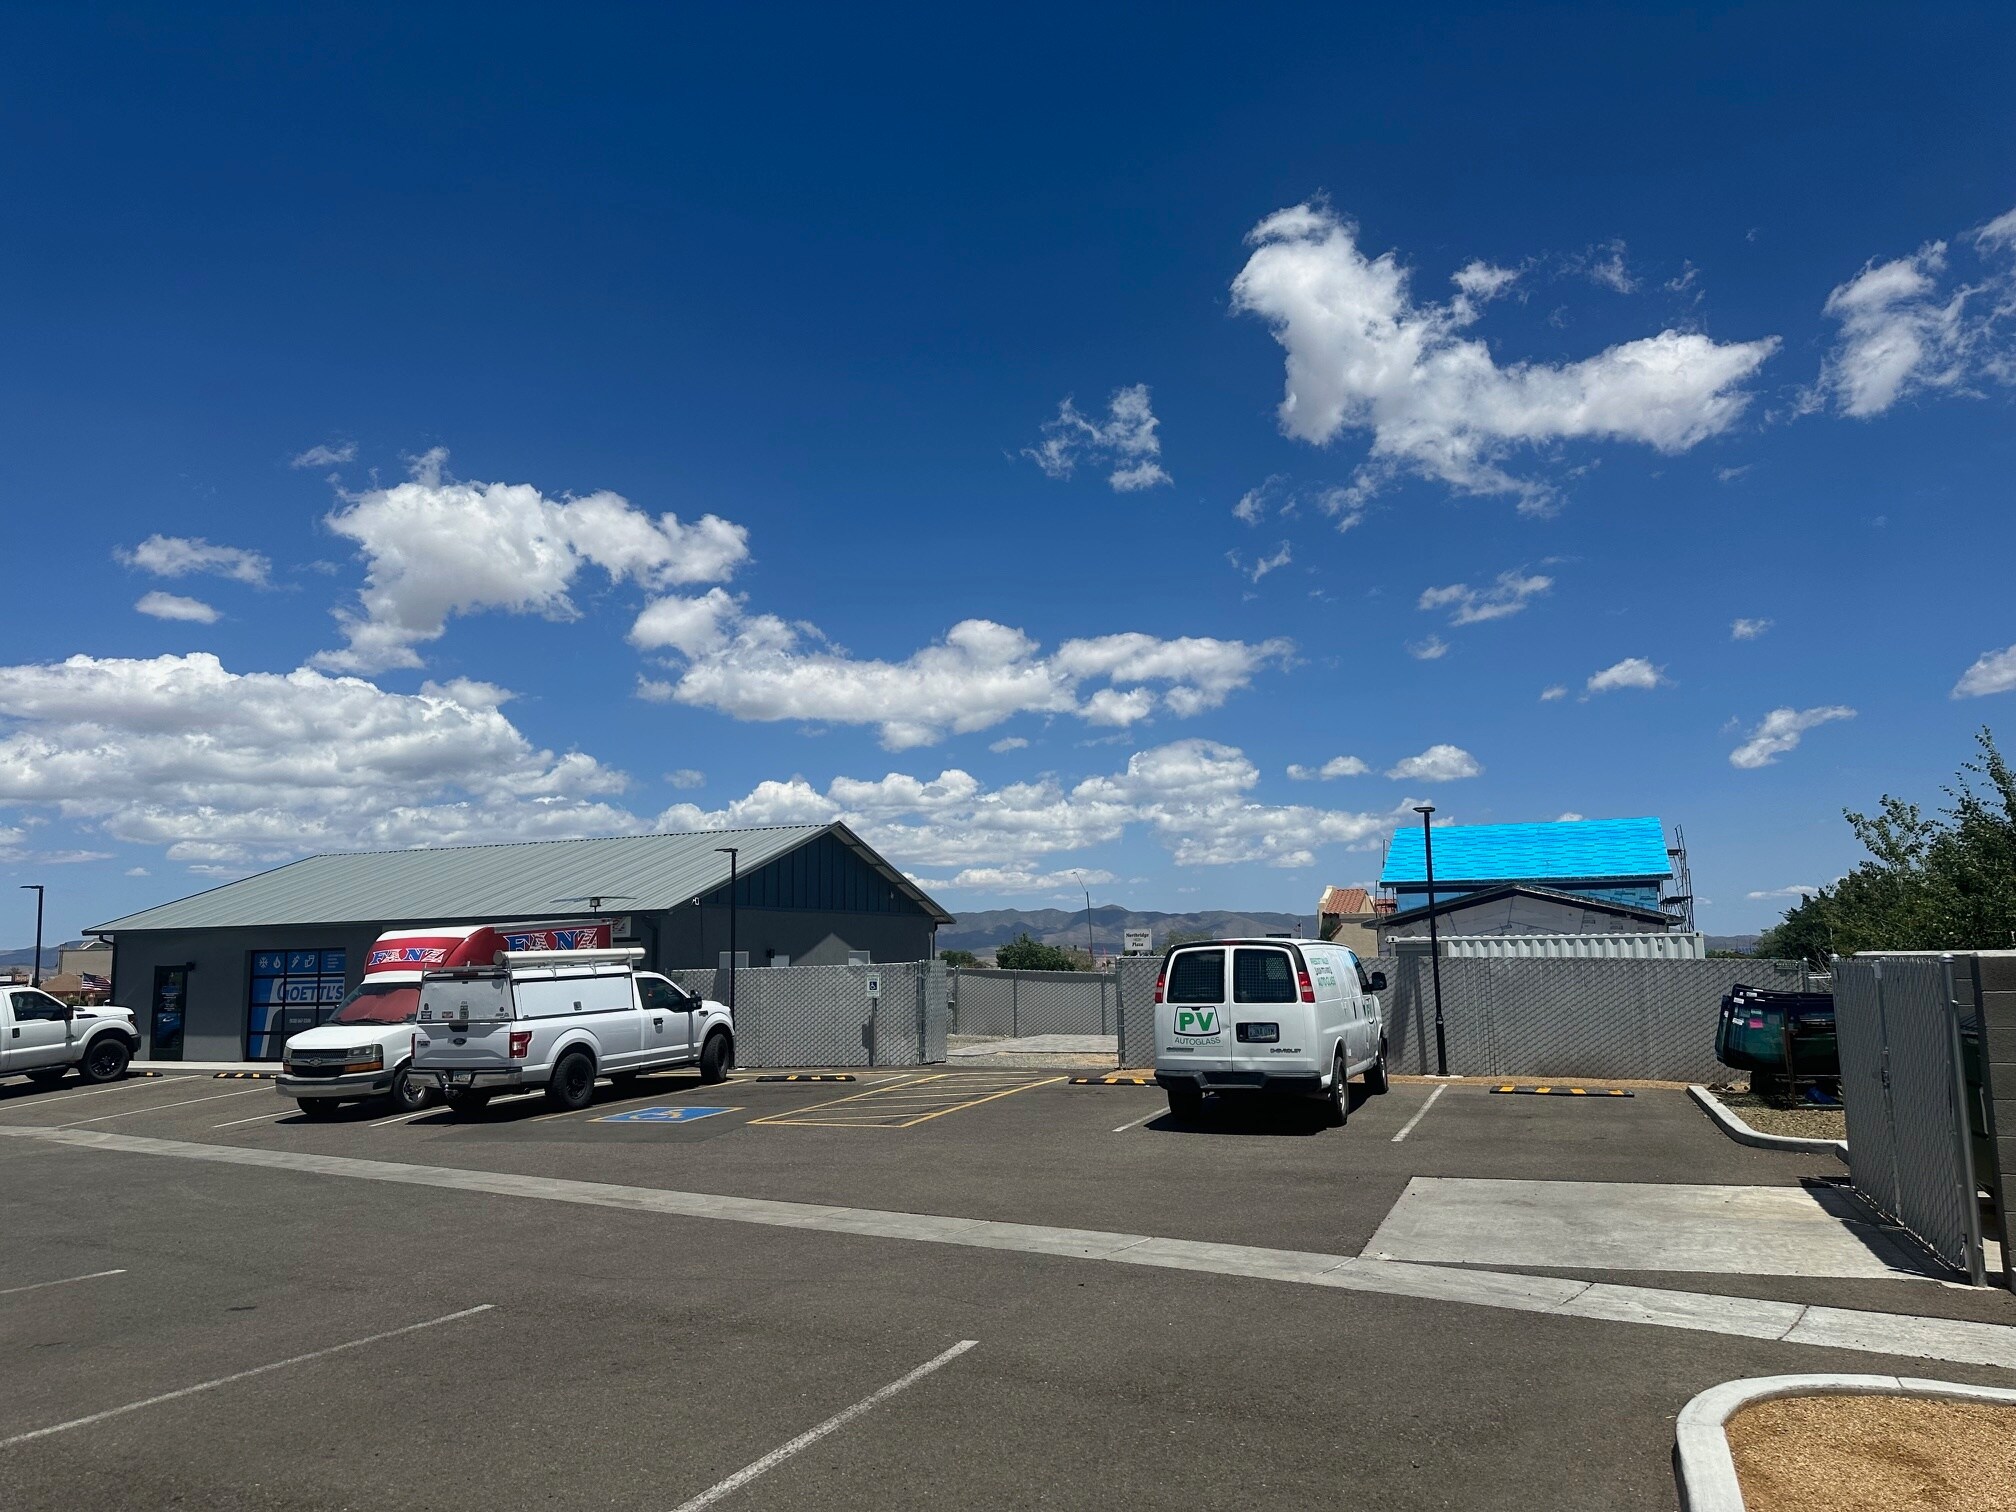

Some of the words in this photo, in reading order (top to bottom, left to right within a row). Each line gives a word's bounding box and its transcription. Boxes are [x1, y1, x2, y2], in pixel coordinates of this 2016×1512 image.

[503, 928, 597, 950] FANZ
[369, 948, 447, 966] FANZ
[1179, 1012, 1214, 1031] PV
[1174, 1037, 1221, 1045] AUTOGLASS
